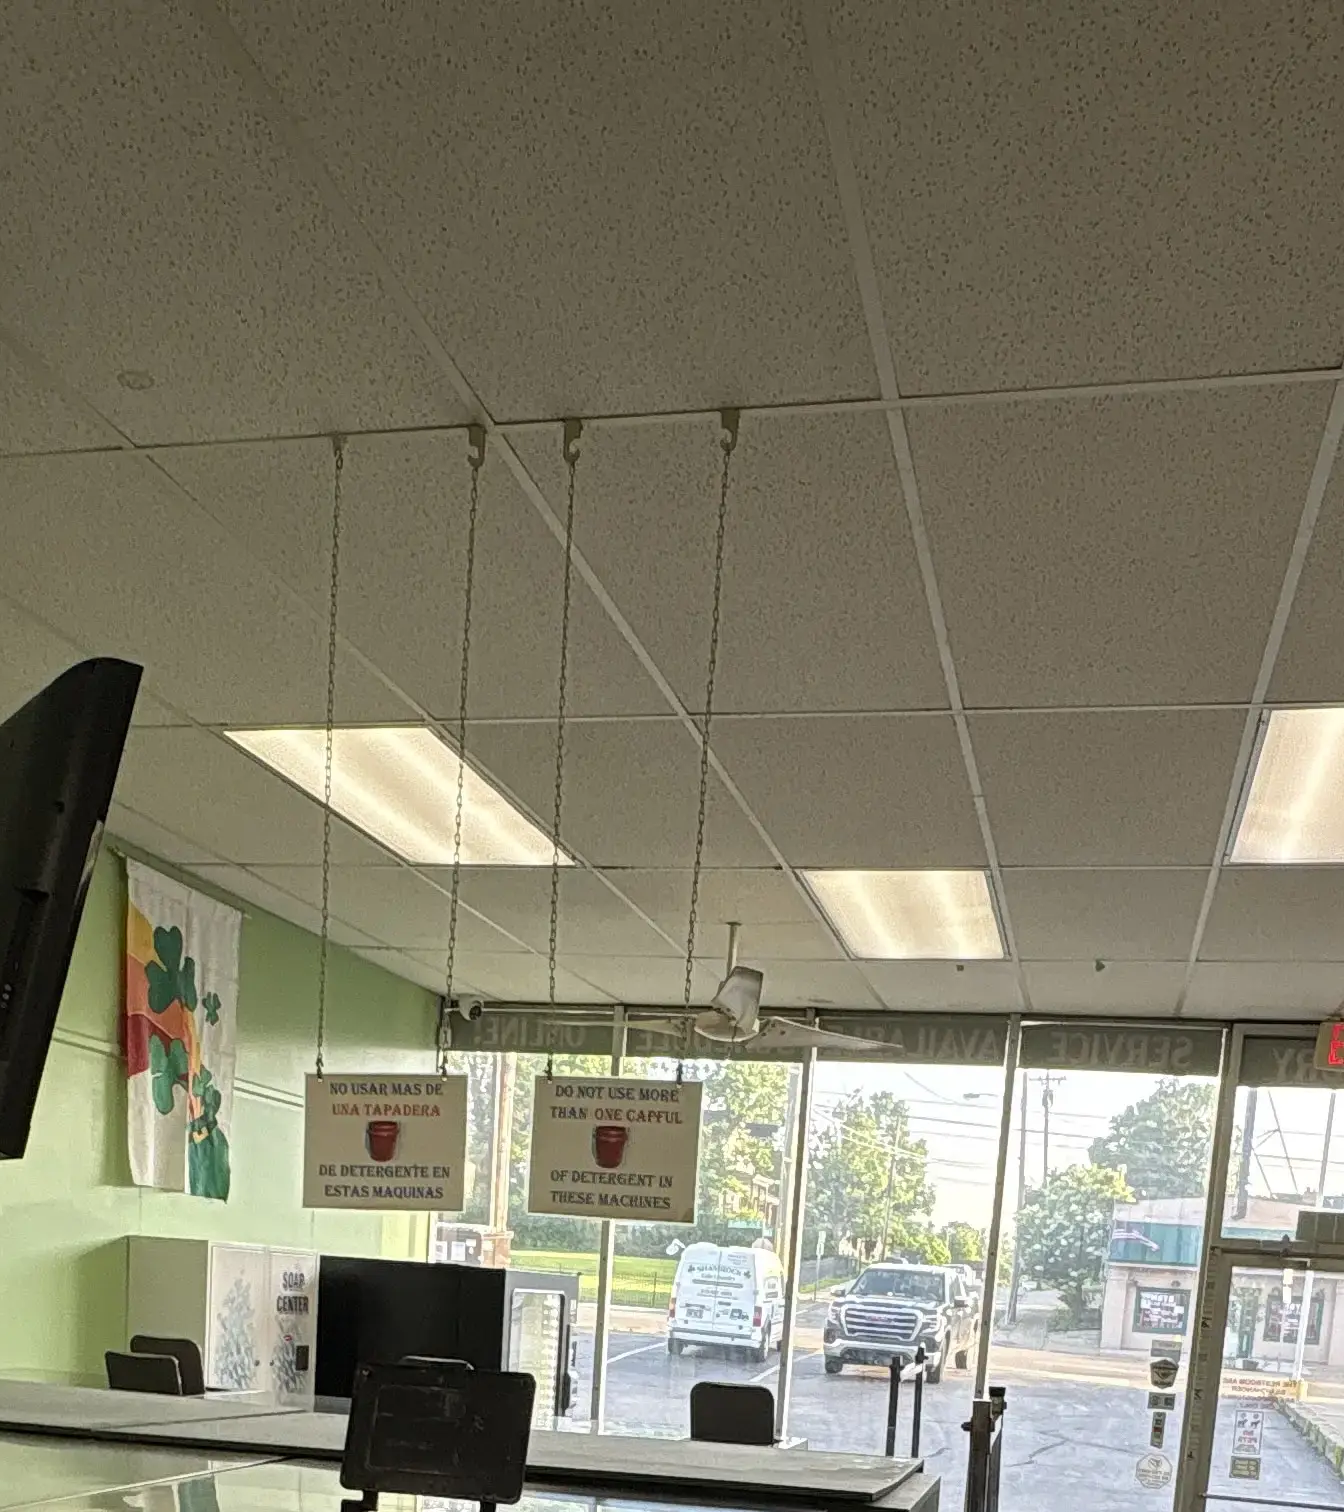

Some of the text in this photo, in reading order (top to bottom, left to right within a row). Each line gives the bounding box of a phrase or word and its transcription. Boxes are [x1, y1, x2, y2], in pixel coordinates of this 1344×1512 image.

[329, 1081, 444, 1097] NO USAR MAS DE
[555, 1085, 680, 1103] DO NOT USE MORE
[332, 1102, 441, 1118] UNA TAPADERA
[550, 1105, 683, 1125] THAN ONE CAPFUL
[319, 1164, 450, 1180] DE DETERGENTE EN
[550, 1170, 673, 1188] OF DETERGENT IN
[324, 1185, 444, 1200] ESTAS MAQUINAS
[550, 1191, 671, 1210] THESE MACHINES
[281, 1271, 305, 1290] SOAP
[276, 1295, 309, 1315] CENTER
